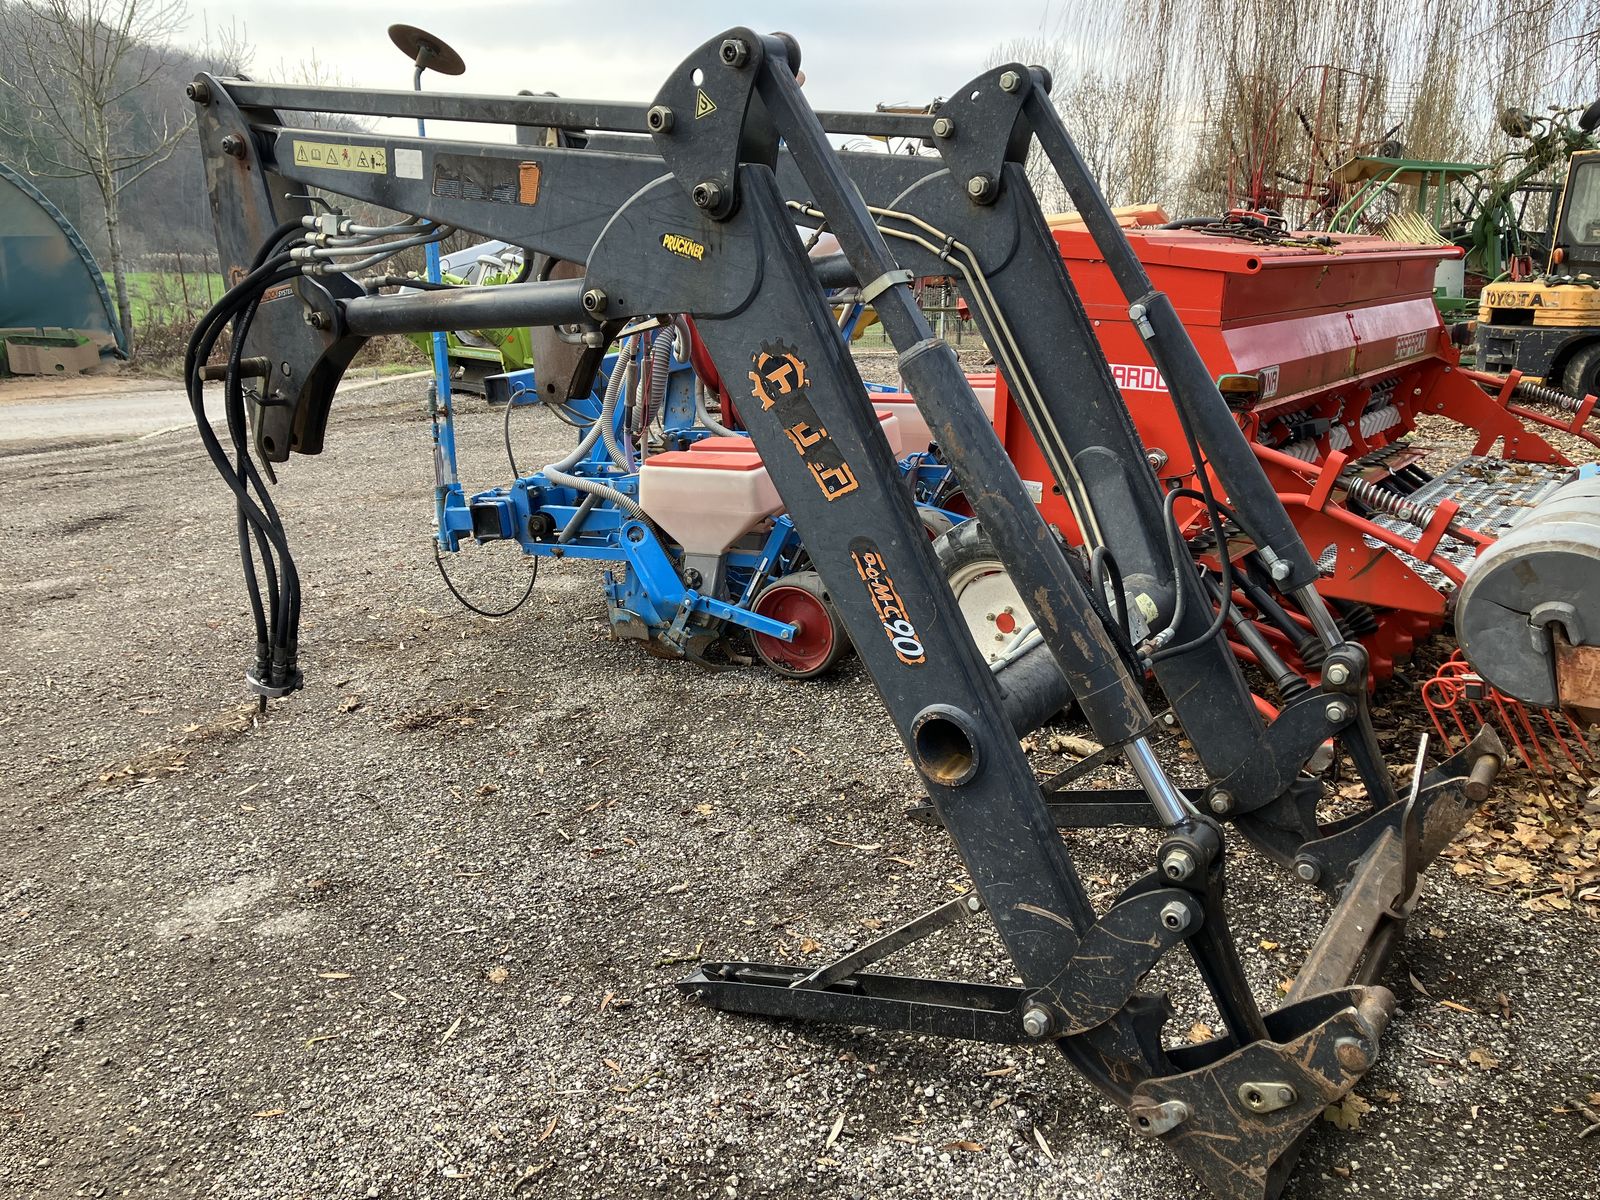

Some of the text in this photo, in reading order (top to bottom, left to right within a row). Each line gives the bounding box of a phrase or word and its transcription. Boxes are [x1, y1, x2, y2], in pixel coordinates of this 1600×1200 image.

[662, 234, 704, 260] PRUCKNER
[1485, 292, 1545, 307] TOYOTA
[1112, 366, 1168, 390] ARDO
[883, 617, 926, 658] 90
